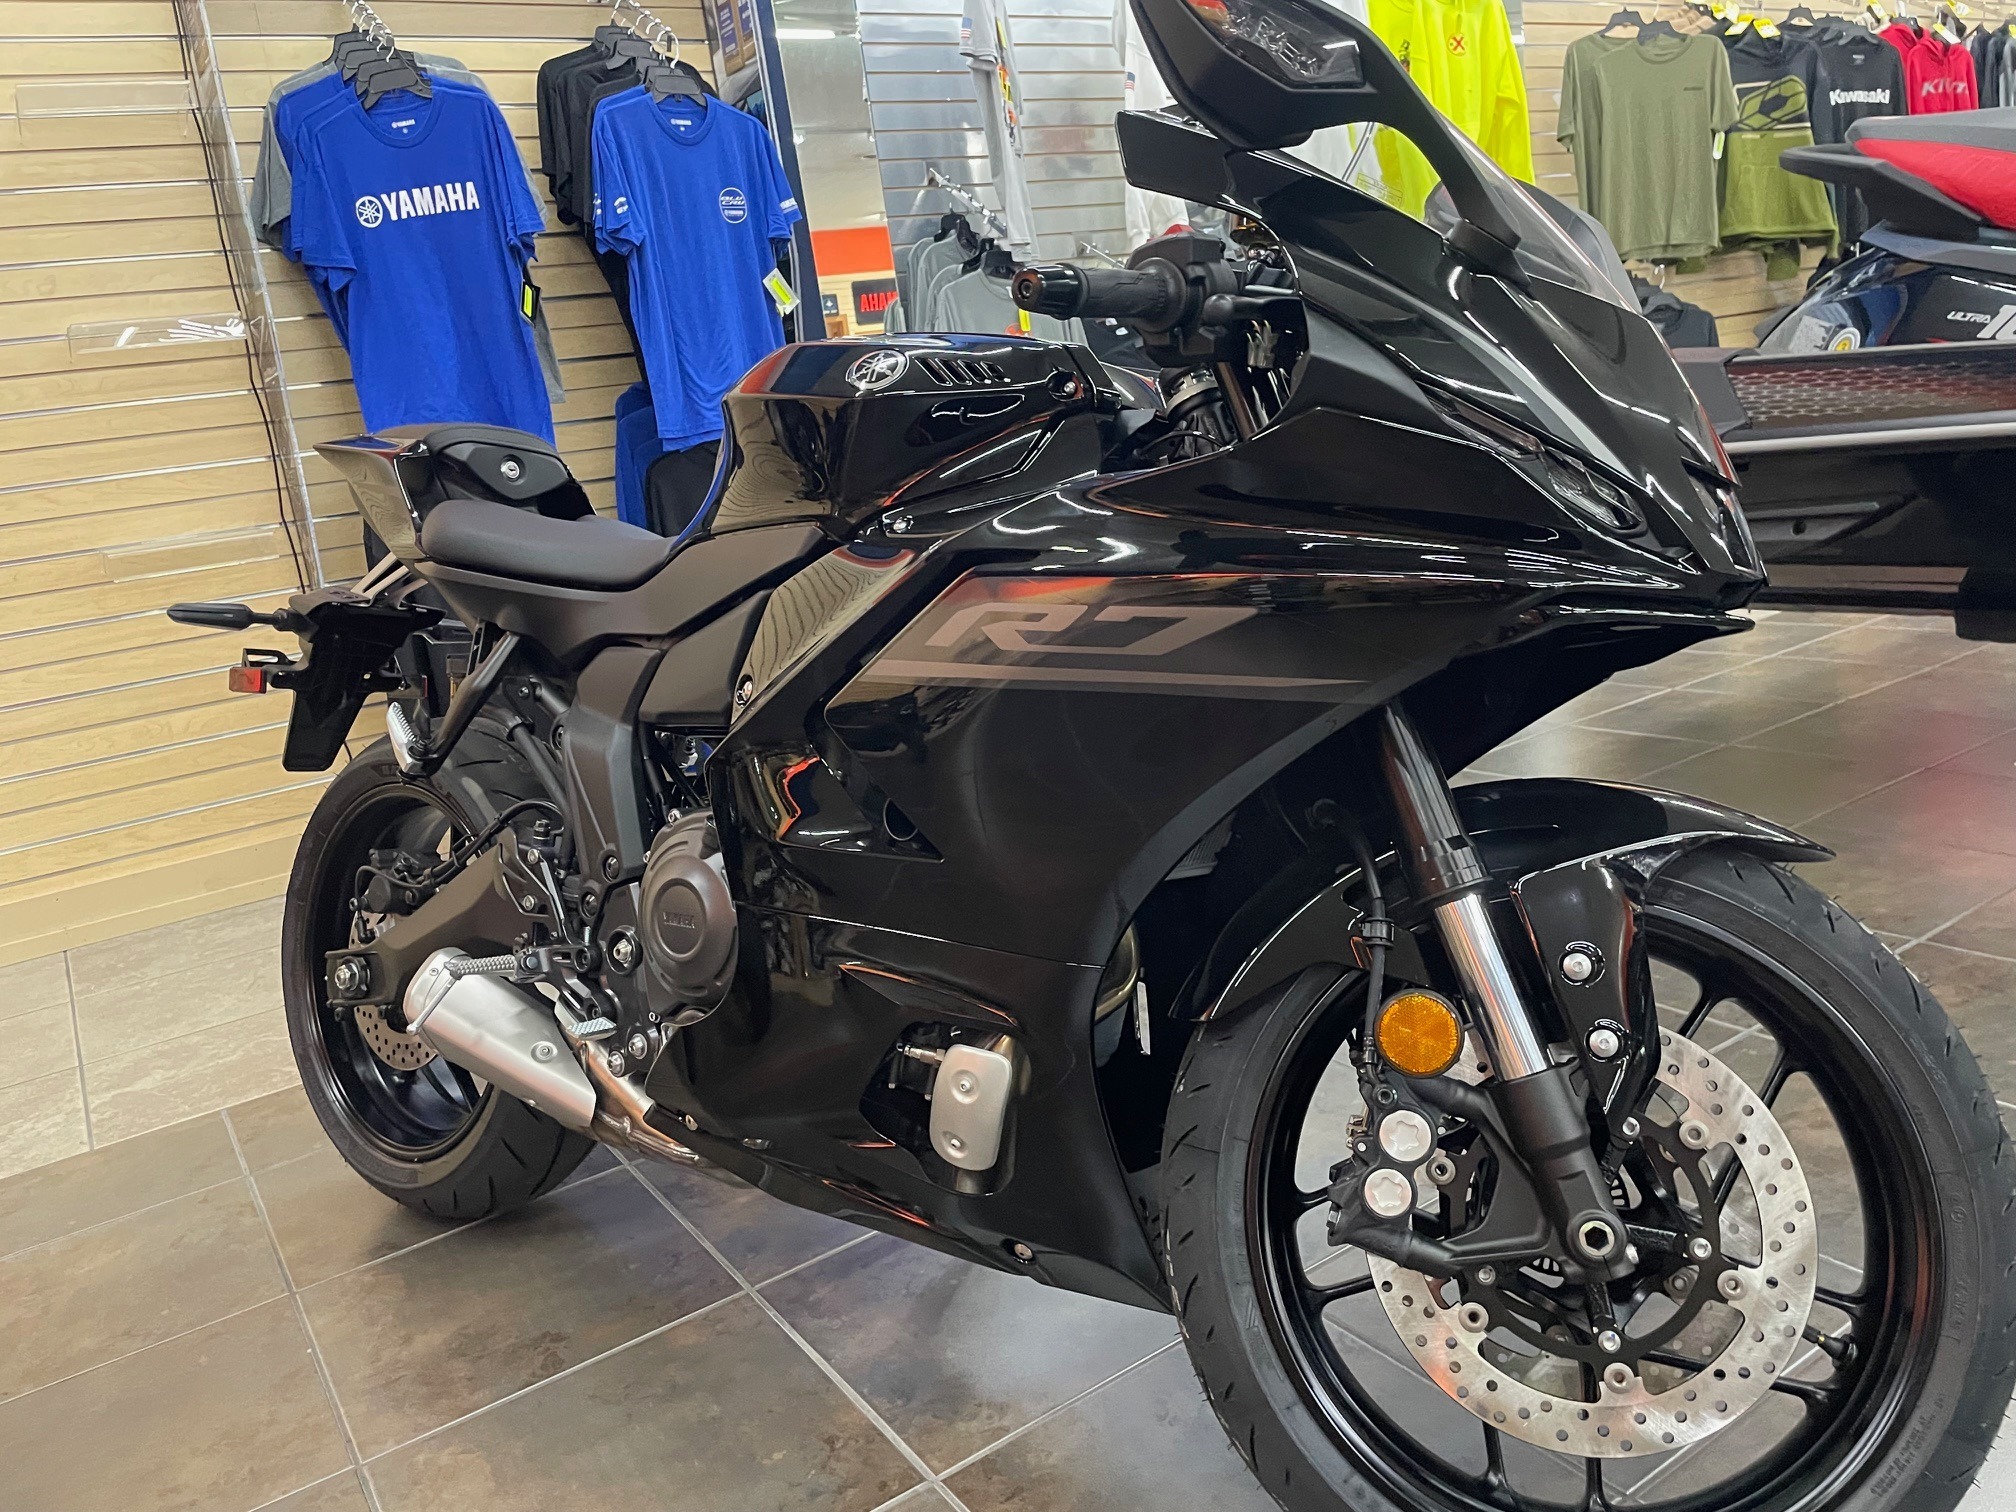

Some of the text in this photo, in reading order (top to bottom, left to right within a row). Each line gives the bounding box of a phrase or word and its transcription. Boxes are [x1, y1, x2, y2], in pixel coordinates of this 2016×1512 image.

[1829, 88, 1891, 106] Kawasaki
[380, 181, 480, 221] YAMAHA
[1946, 310, 1991, 324] ULTRA
[924, 601, 1261, 656] R7
